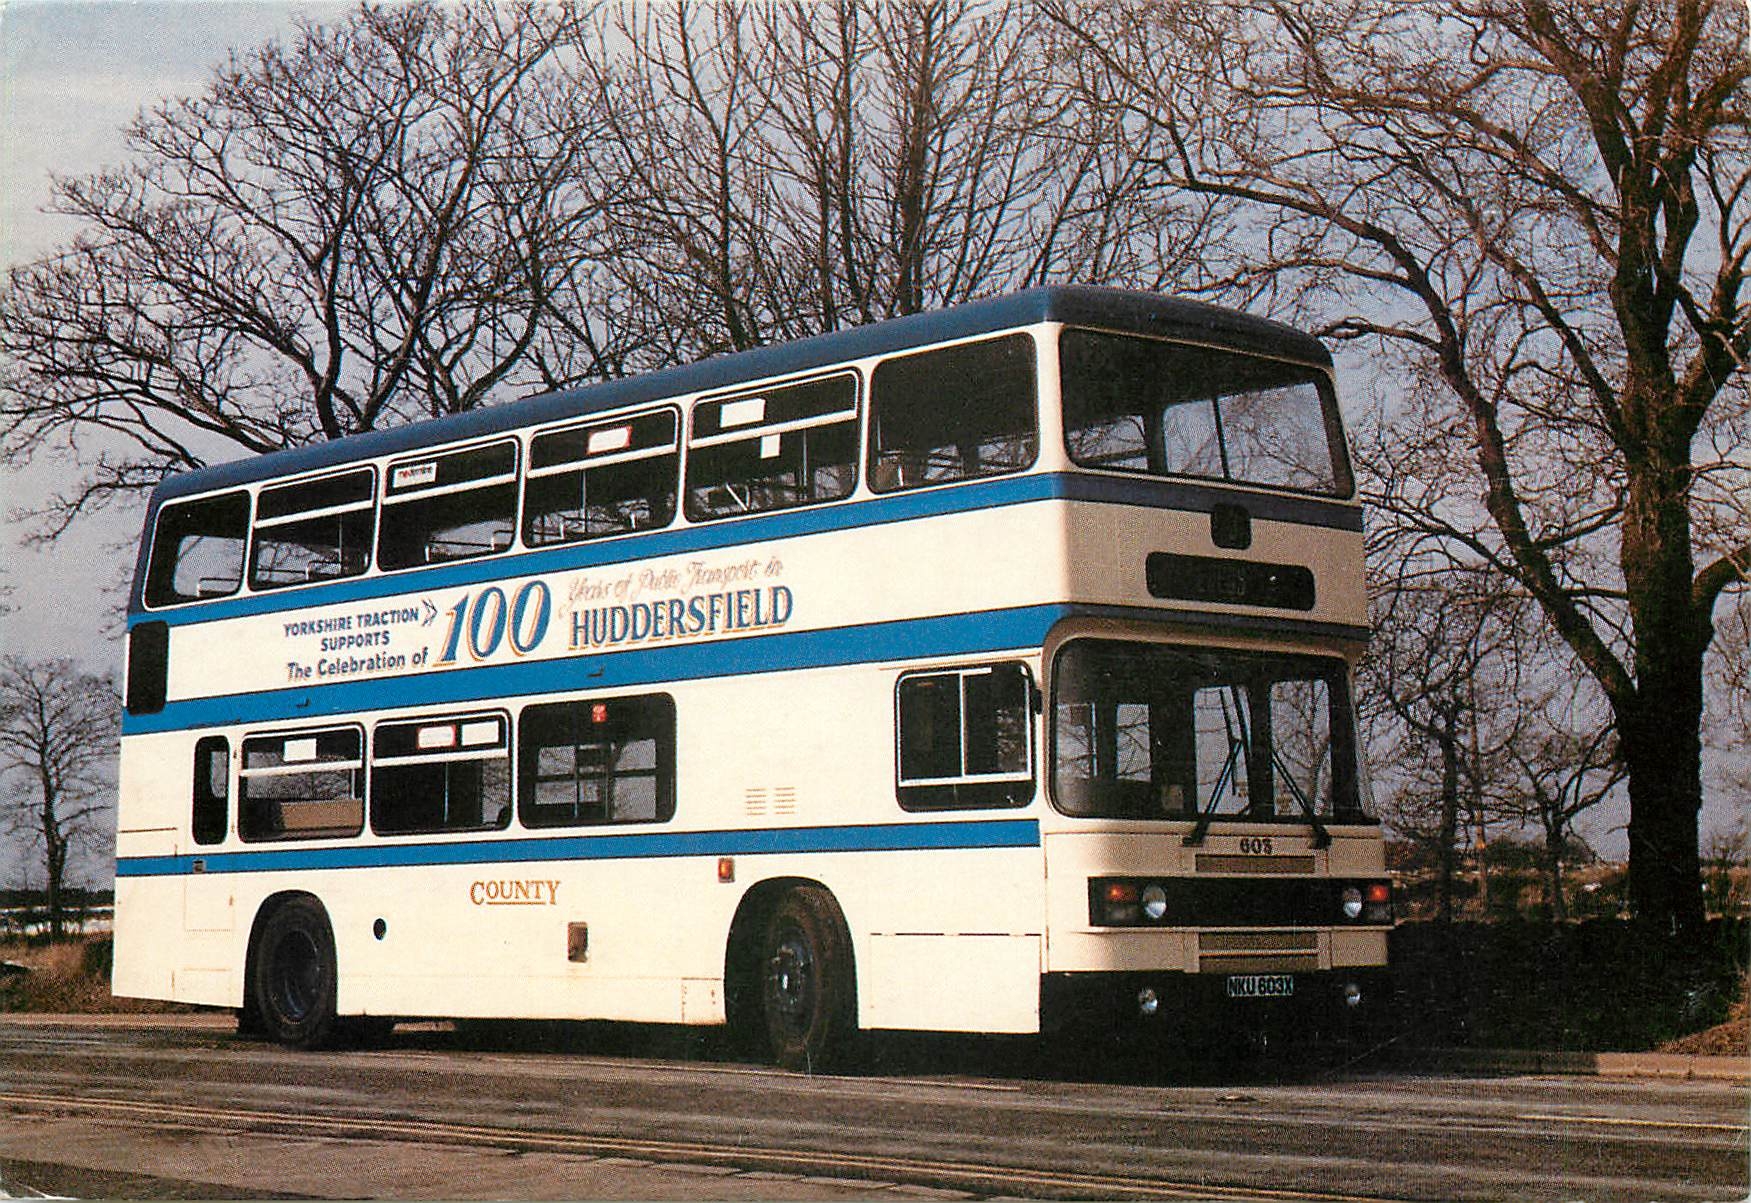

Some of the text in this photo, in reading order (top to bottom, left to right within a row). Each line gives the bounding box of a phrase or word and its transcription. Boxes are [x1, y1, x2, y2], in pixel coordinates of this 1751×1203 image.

[681, 560, 762, 594] Transport
[764, 556, 784, 577] in
[283, 607, 419, 637] YORKSHIRE TRACTION
[432, 580, 551, 667] 100
[568, 586, 794, 651] HUDDERSFIELD
[321, 630, 390, 652] SUPPORTS
[287, 646, 429, 682] The Celebration of
[470, 880, 561, 905] COUNTY
[1229, 976, 1293, 996] NKU 603X
